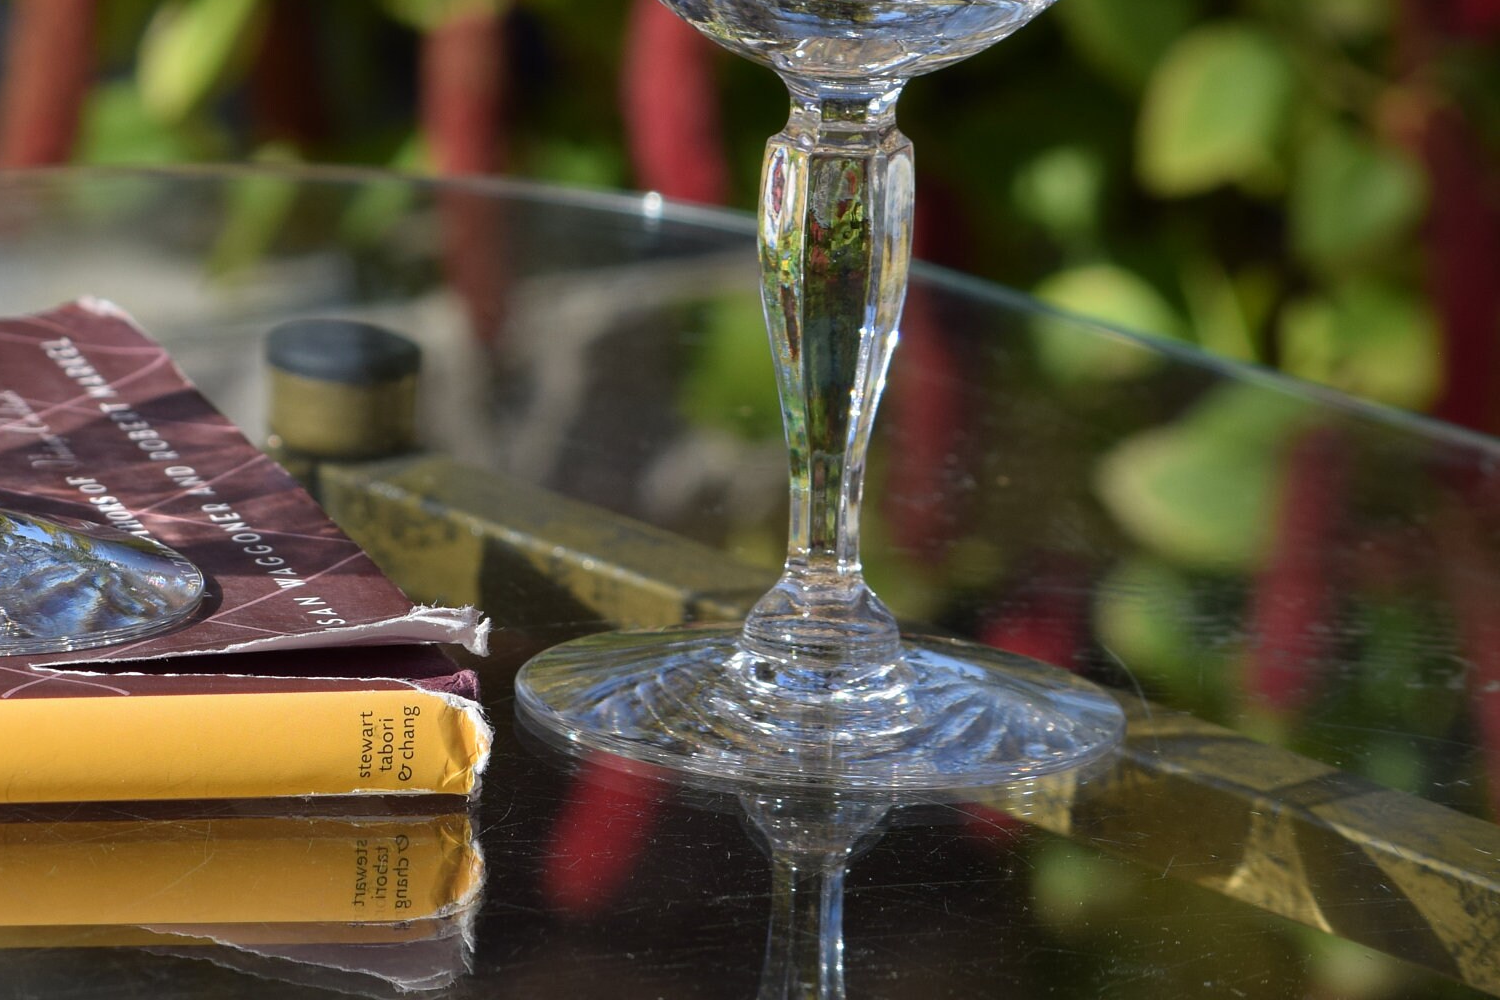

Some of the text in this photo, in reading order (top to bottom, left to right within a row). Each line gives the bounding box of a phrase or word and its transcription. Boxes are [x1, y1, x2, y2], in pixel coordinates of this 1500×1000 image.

[99, 402, 181, 461] ROBERT
[65, 476, 107, 494] OF
[164, 465, 216, 495] AND
[201, 503, 307, 589] WAGGONER
[293, 596, 347, 632] SAN
[359, 710, 373, 778] stewart
[377, 717, 394, 772] tabori
[398, 705, 421, 760] chang
